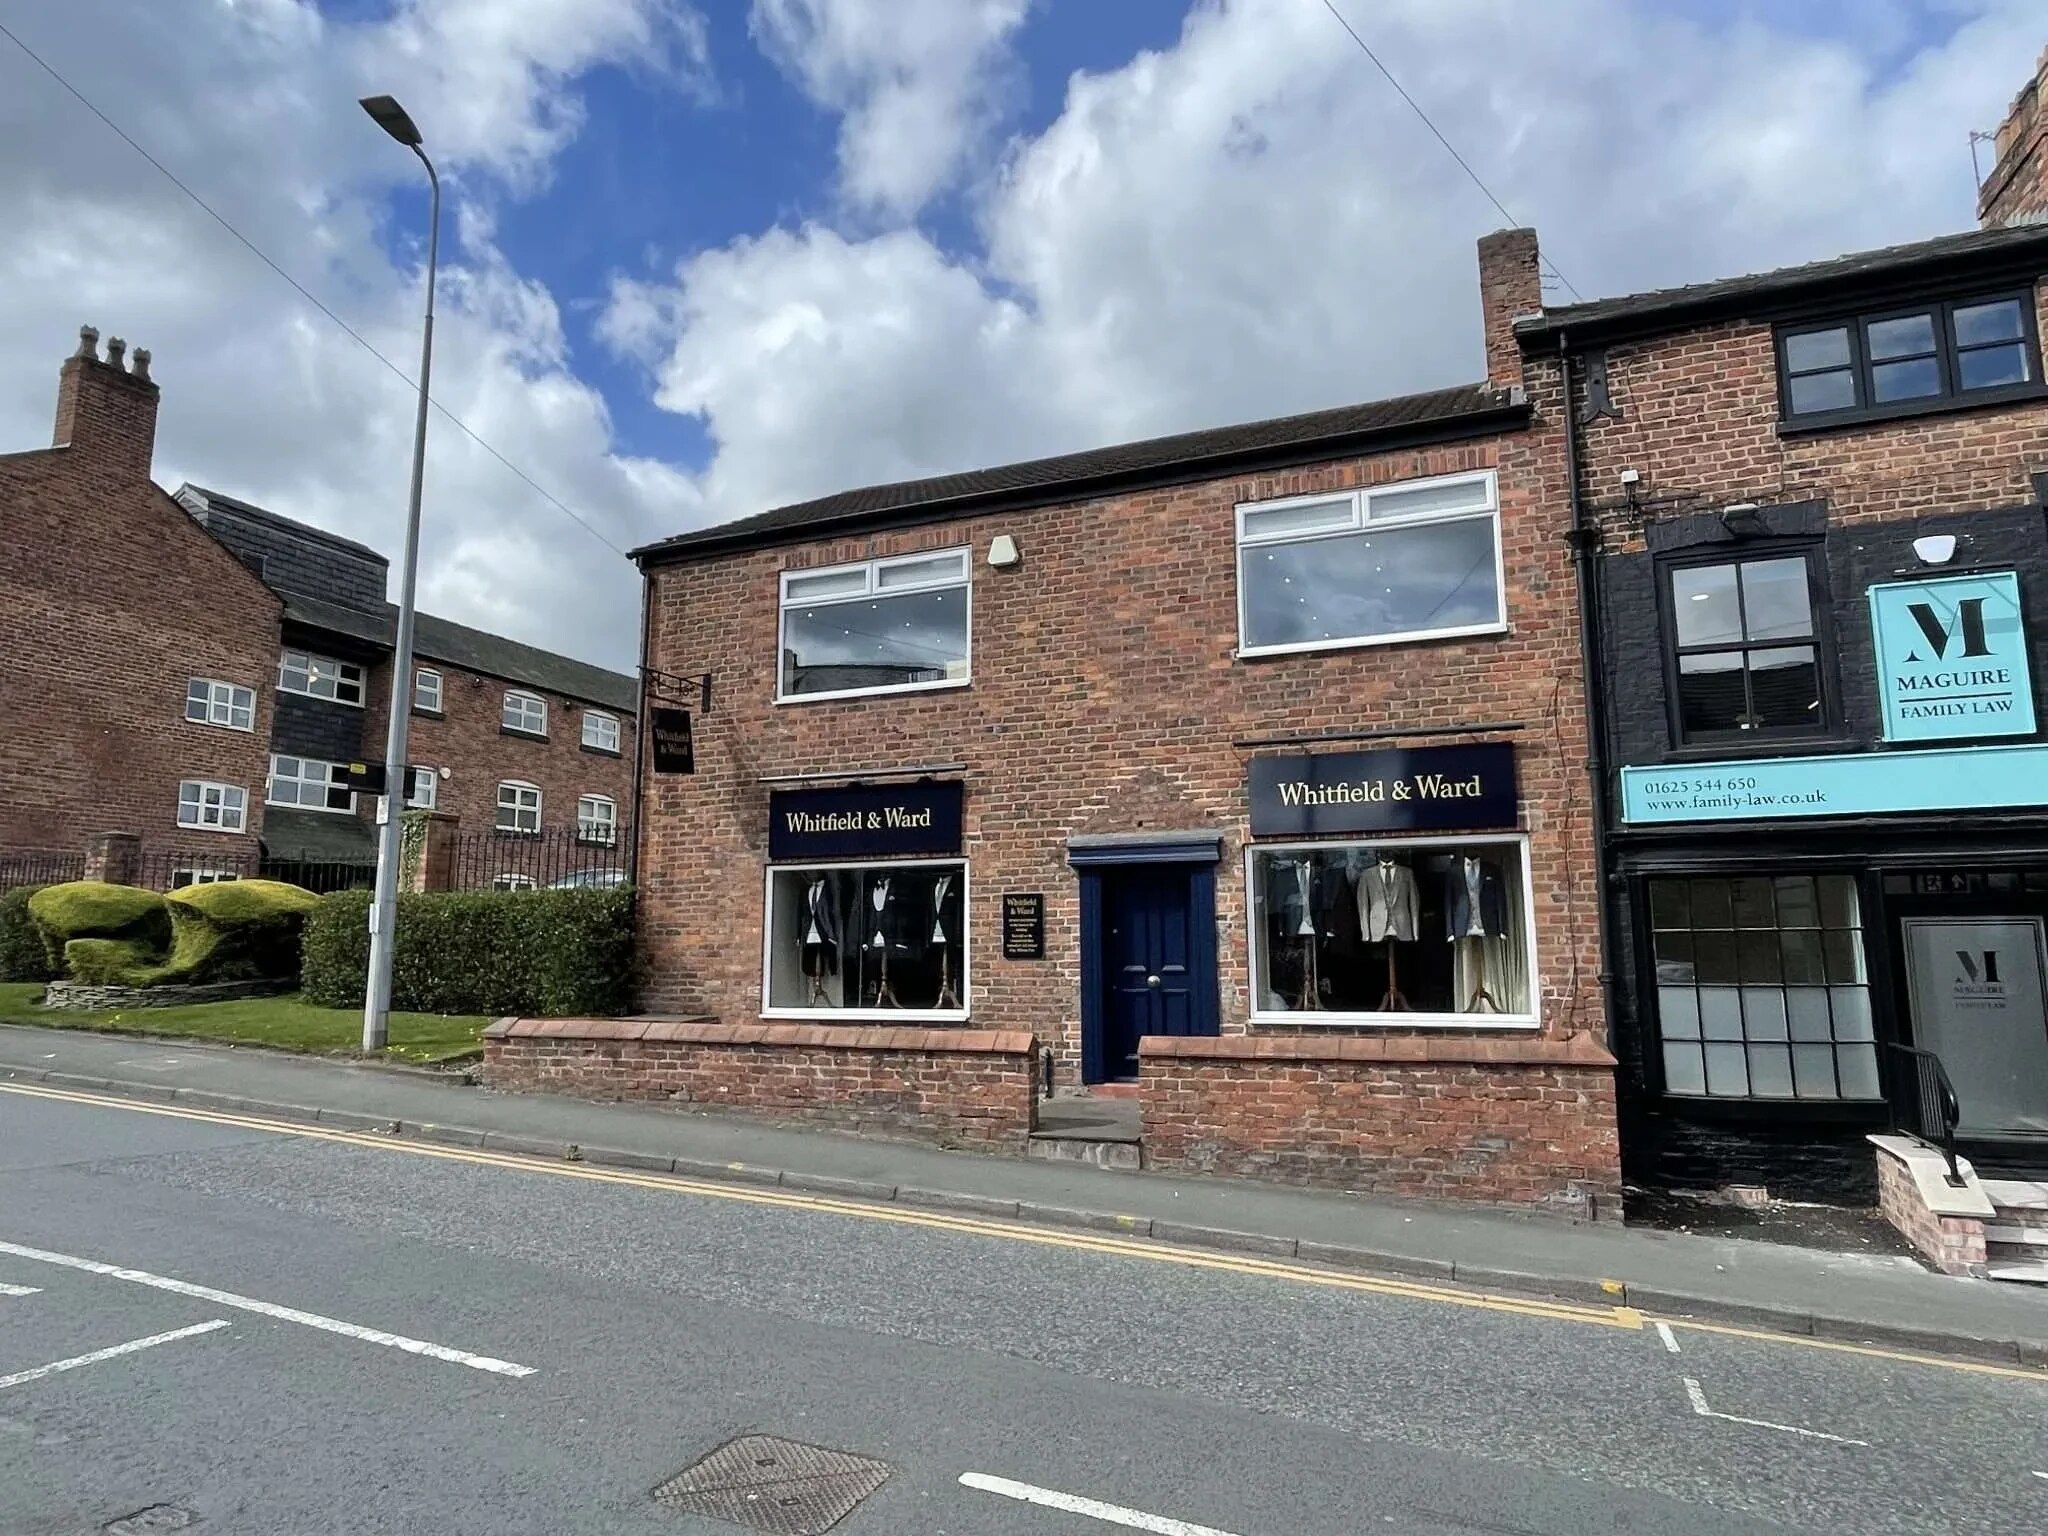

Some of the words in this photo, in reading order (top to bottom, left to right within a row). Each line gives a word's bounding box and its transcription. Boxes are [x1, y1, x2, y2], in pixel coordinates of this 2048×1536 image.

[1896, 668, 2011, 691] MAGUIRE
[1901, 702, 1967, 719] FAMILY
[1973, 700, 2013, 714] LAW
[1277, 780, 1385, 806] Whitfield
[1391, 780, 1412, 800] &
[1414, 774, 1482, 799] Ward
[1644, 780, 1689, 795] 01625
[1693, 778, 1722, 793] 544
[1727, 777, 1757, 791] 650
[1647, 789, 1827, 811] www.family-law.co.uk
[785, 811, 863, 833] Whitfield
[867, 811, 883, 829] &
[884, 807, 931, 828] Ward
